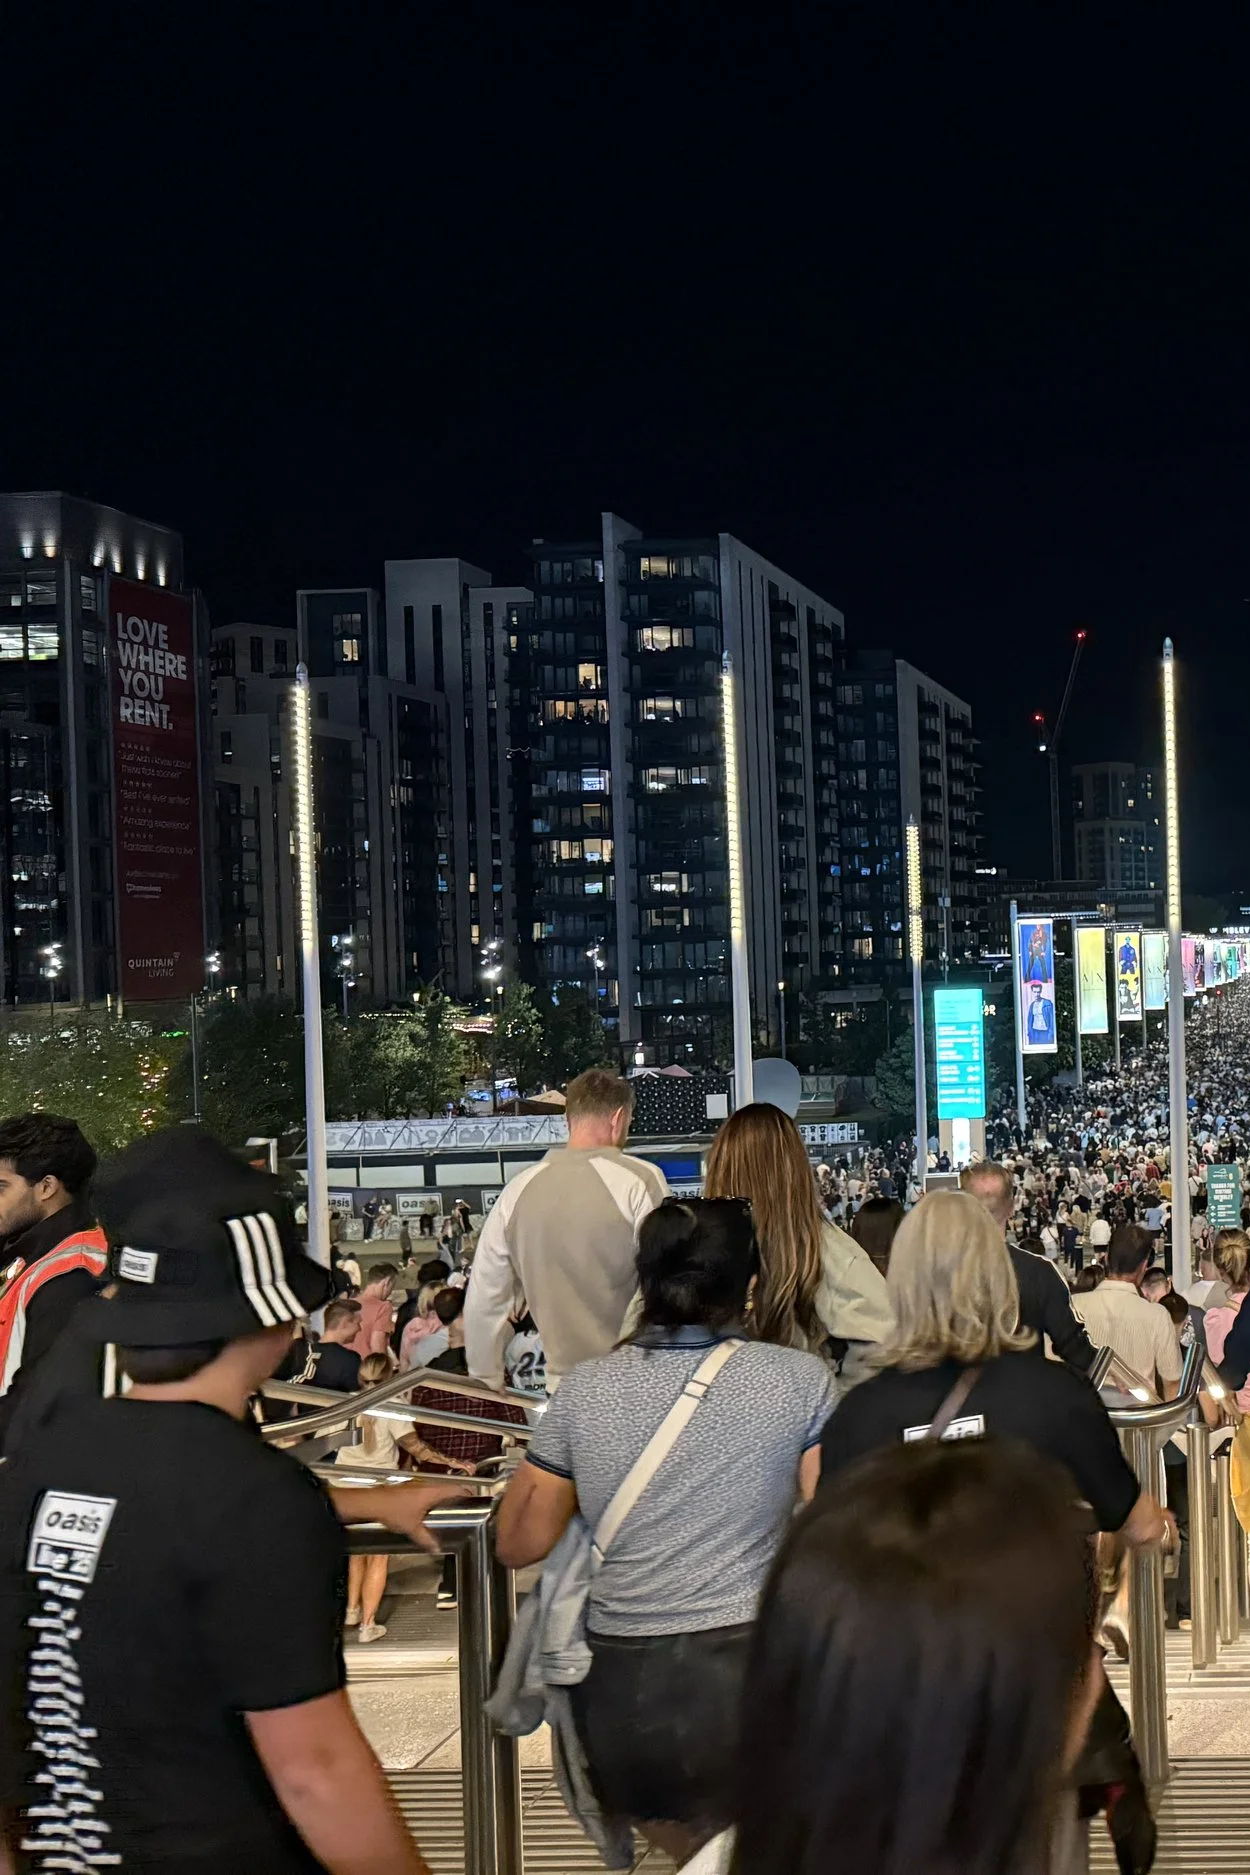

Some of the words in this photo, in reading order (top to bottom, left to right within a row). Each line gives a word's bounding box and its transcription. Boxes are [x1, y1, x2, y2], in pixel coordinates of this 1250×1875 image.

[116, 612, 169, 650] LOVE
[117, 640, 187, 681] WHERE
[118, 668, 164, 701] YOU
[119, 696, 174, 730] RENT.
[128, 957, 174, 970] QUINTAIN
[328, 1198, 350, 1208] asis
